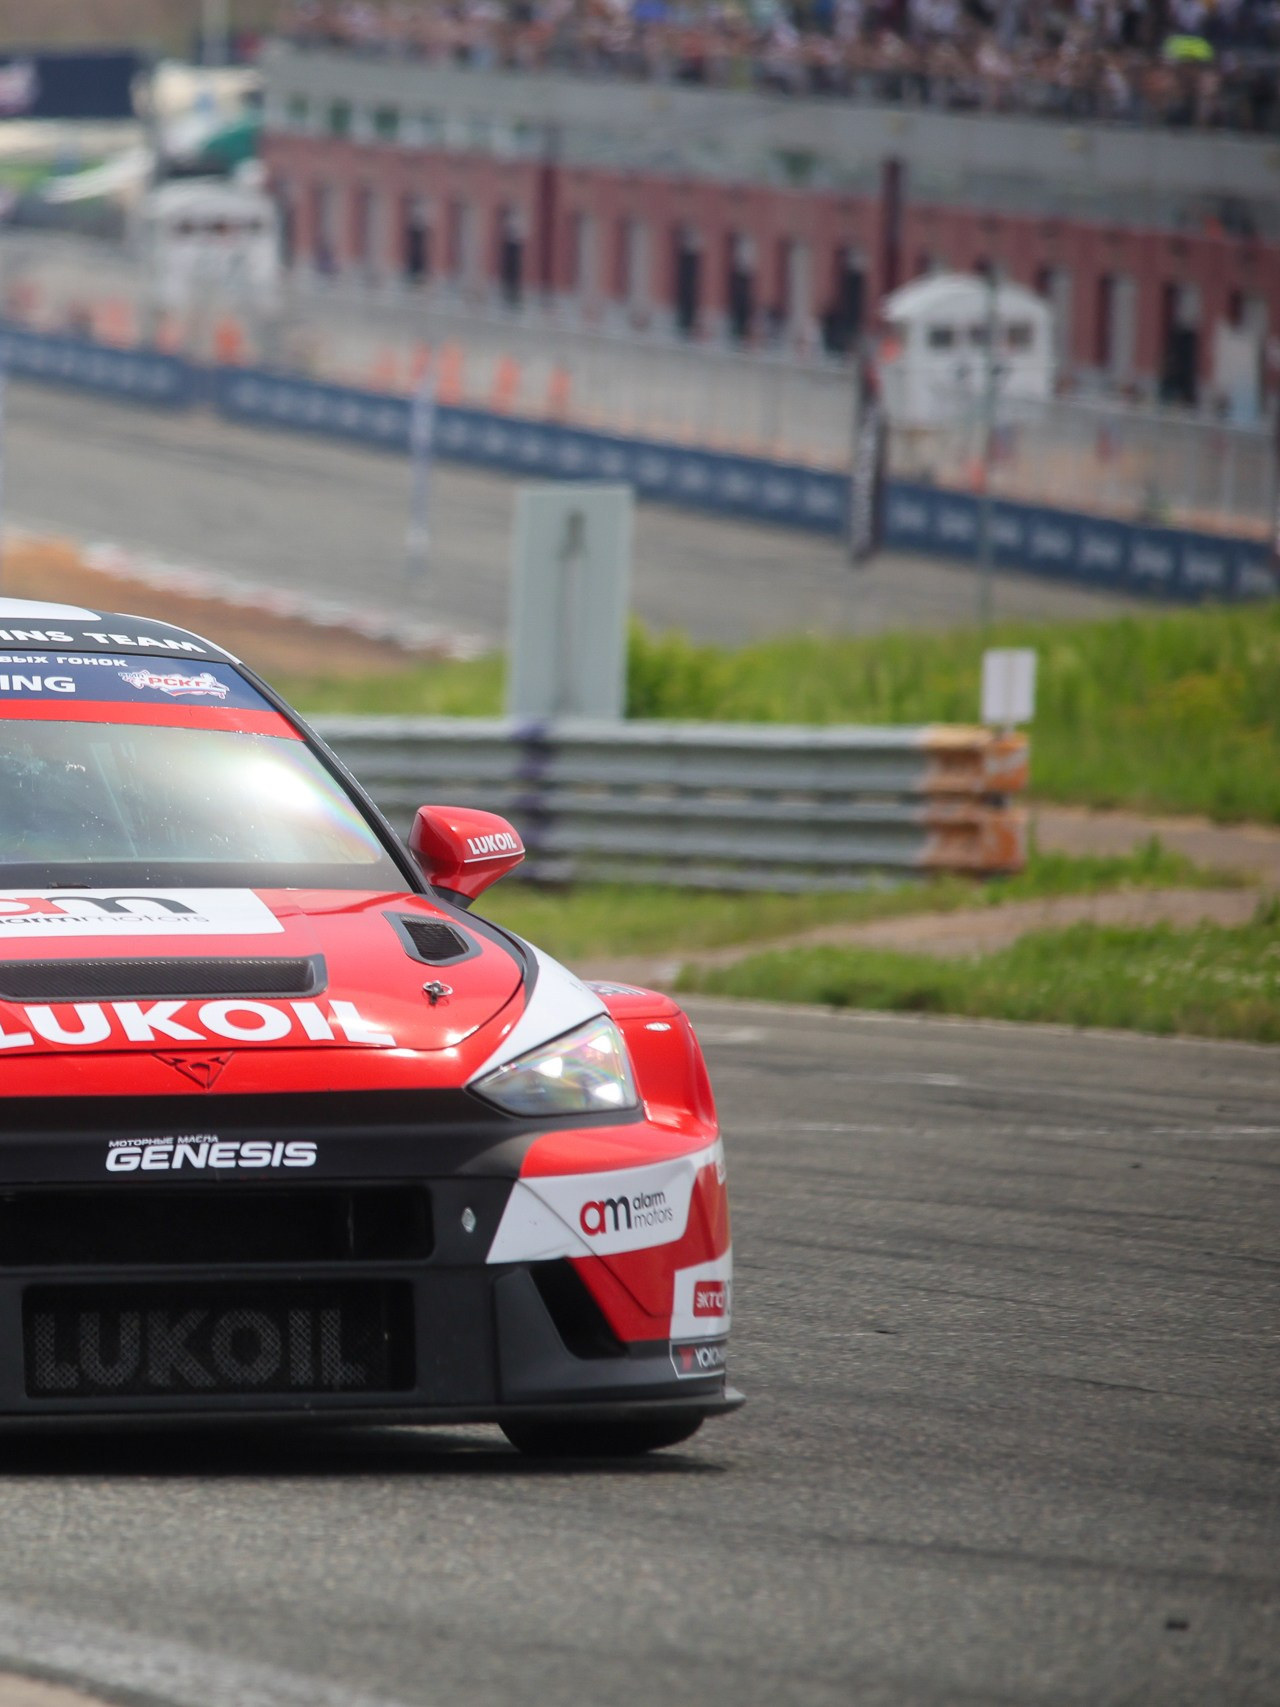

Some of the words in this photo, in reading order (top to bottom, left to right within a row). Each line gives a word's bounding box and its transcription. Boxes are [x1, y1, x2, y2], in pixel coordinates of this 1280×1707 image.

[83, 632, 208, 654] TEAM
[56, 656, 129, 667] гонок
[148, 677, 207, 688] РСКГ
[466, 831, 518, 855] LUKOIL
[108, 1137, 174, 1147] МОТОРНЫЕ
[177, 1134, 219, 1144] МАСЛА
[105, 1141, 318, 1171] GENESIS
[633, 1190, 667, 1211] alarm
[579, 1195, 633, 1237] am
[634, 1206, 674, 1230] motors
[34, 1308, 366, 1390] LUKOIL
